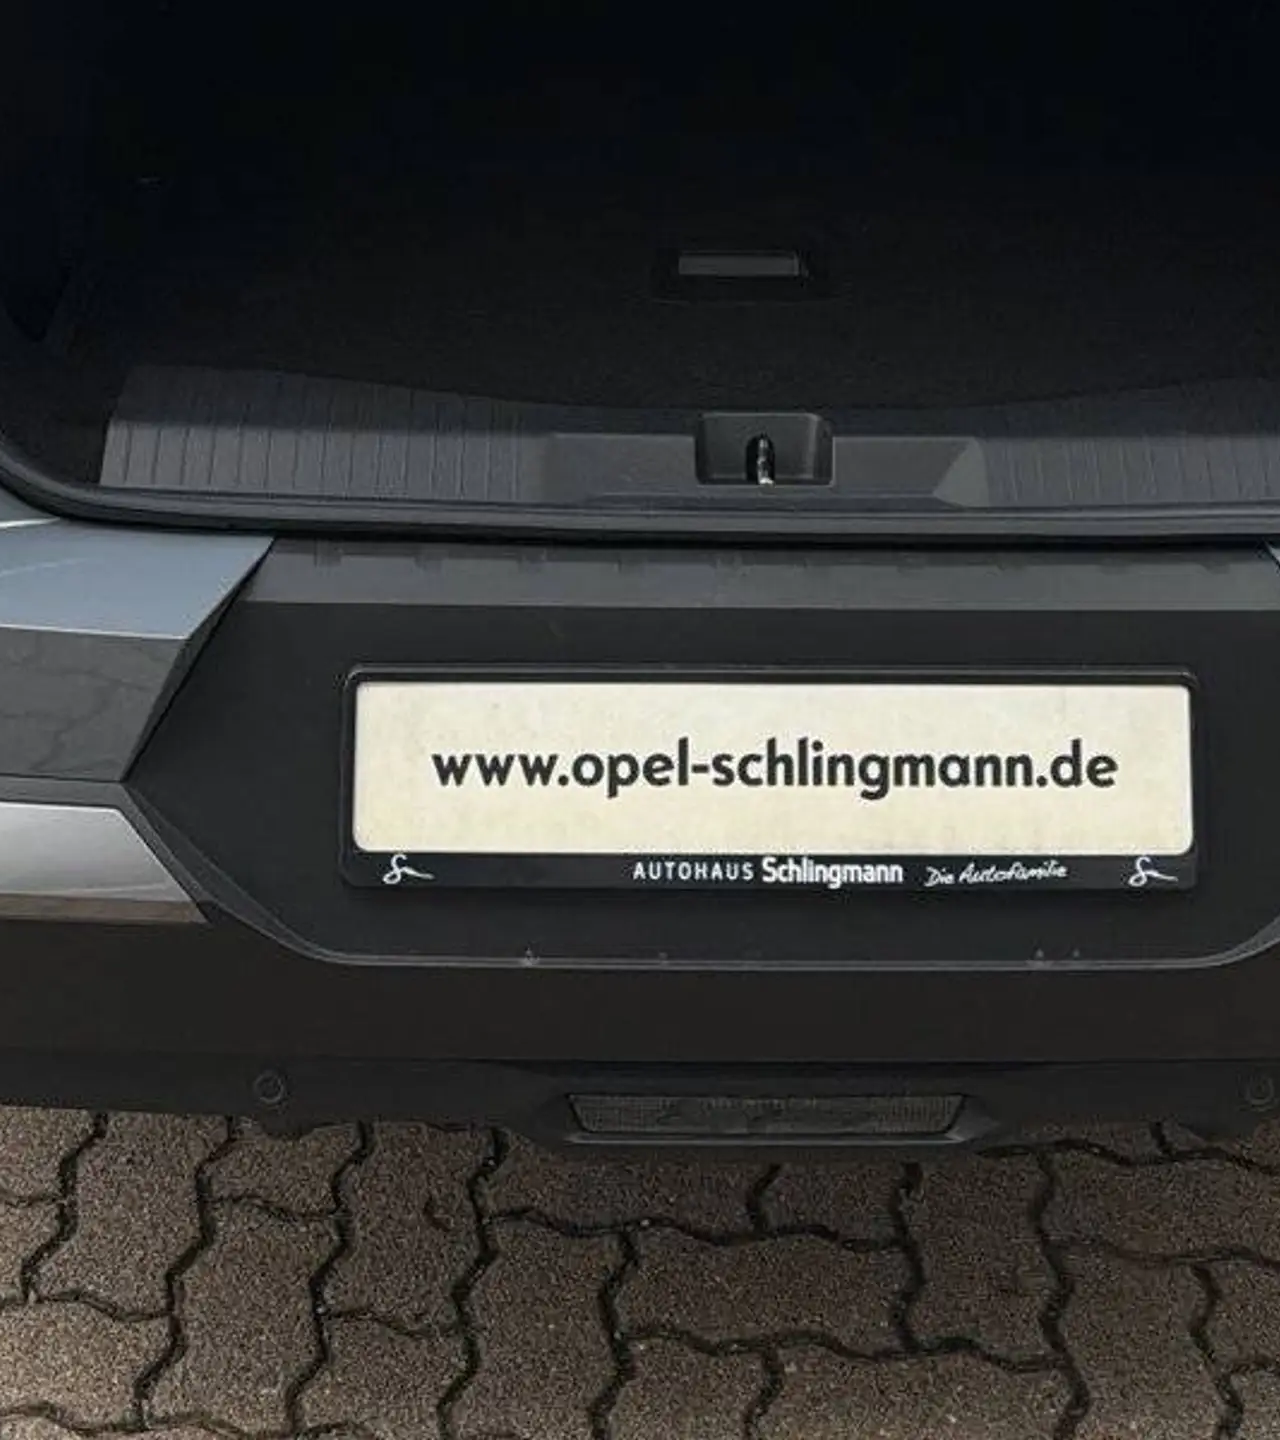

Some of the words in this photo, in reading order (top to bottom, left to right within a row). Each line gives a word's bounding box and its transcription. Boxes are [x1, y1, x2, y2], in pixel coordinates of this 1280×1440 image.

[431, 736, 1119, 801] www.opel-schlingmann.de
[632, 861, 755, 881] AUTOHAUS
[762, 856, 904, 889] Schlingmann
[924, 866, 955, 888] Die
